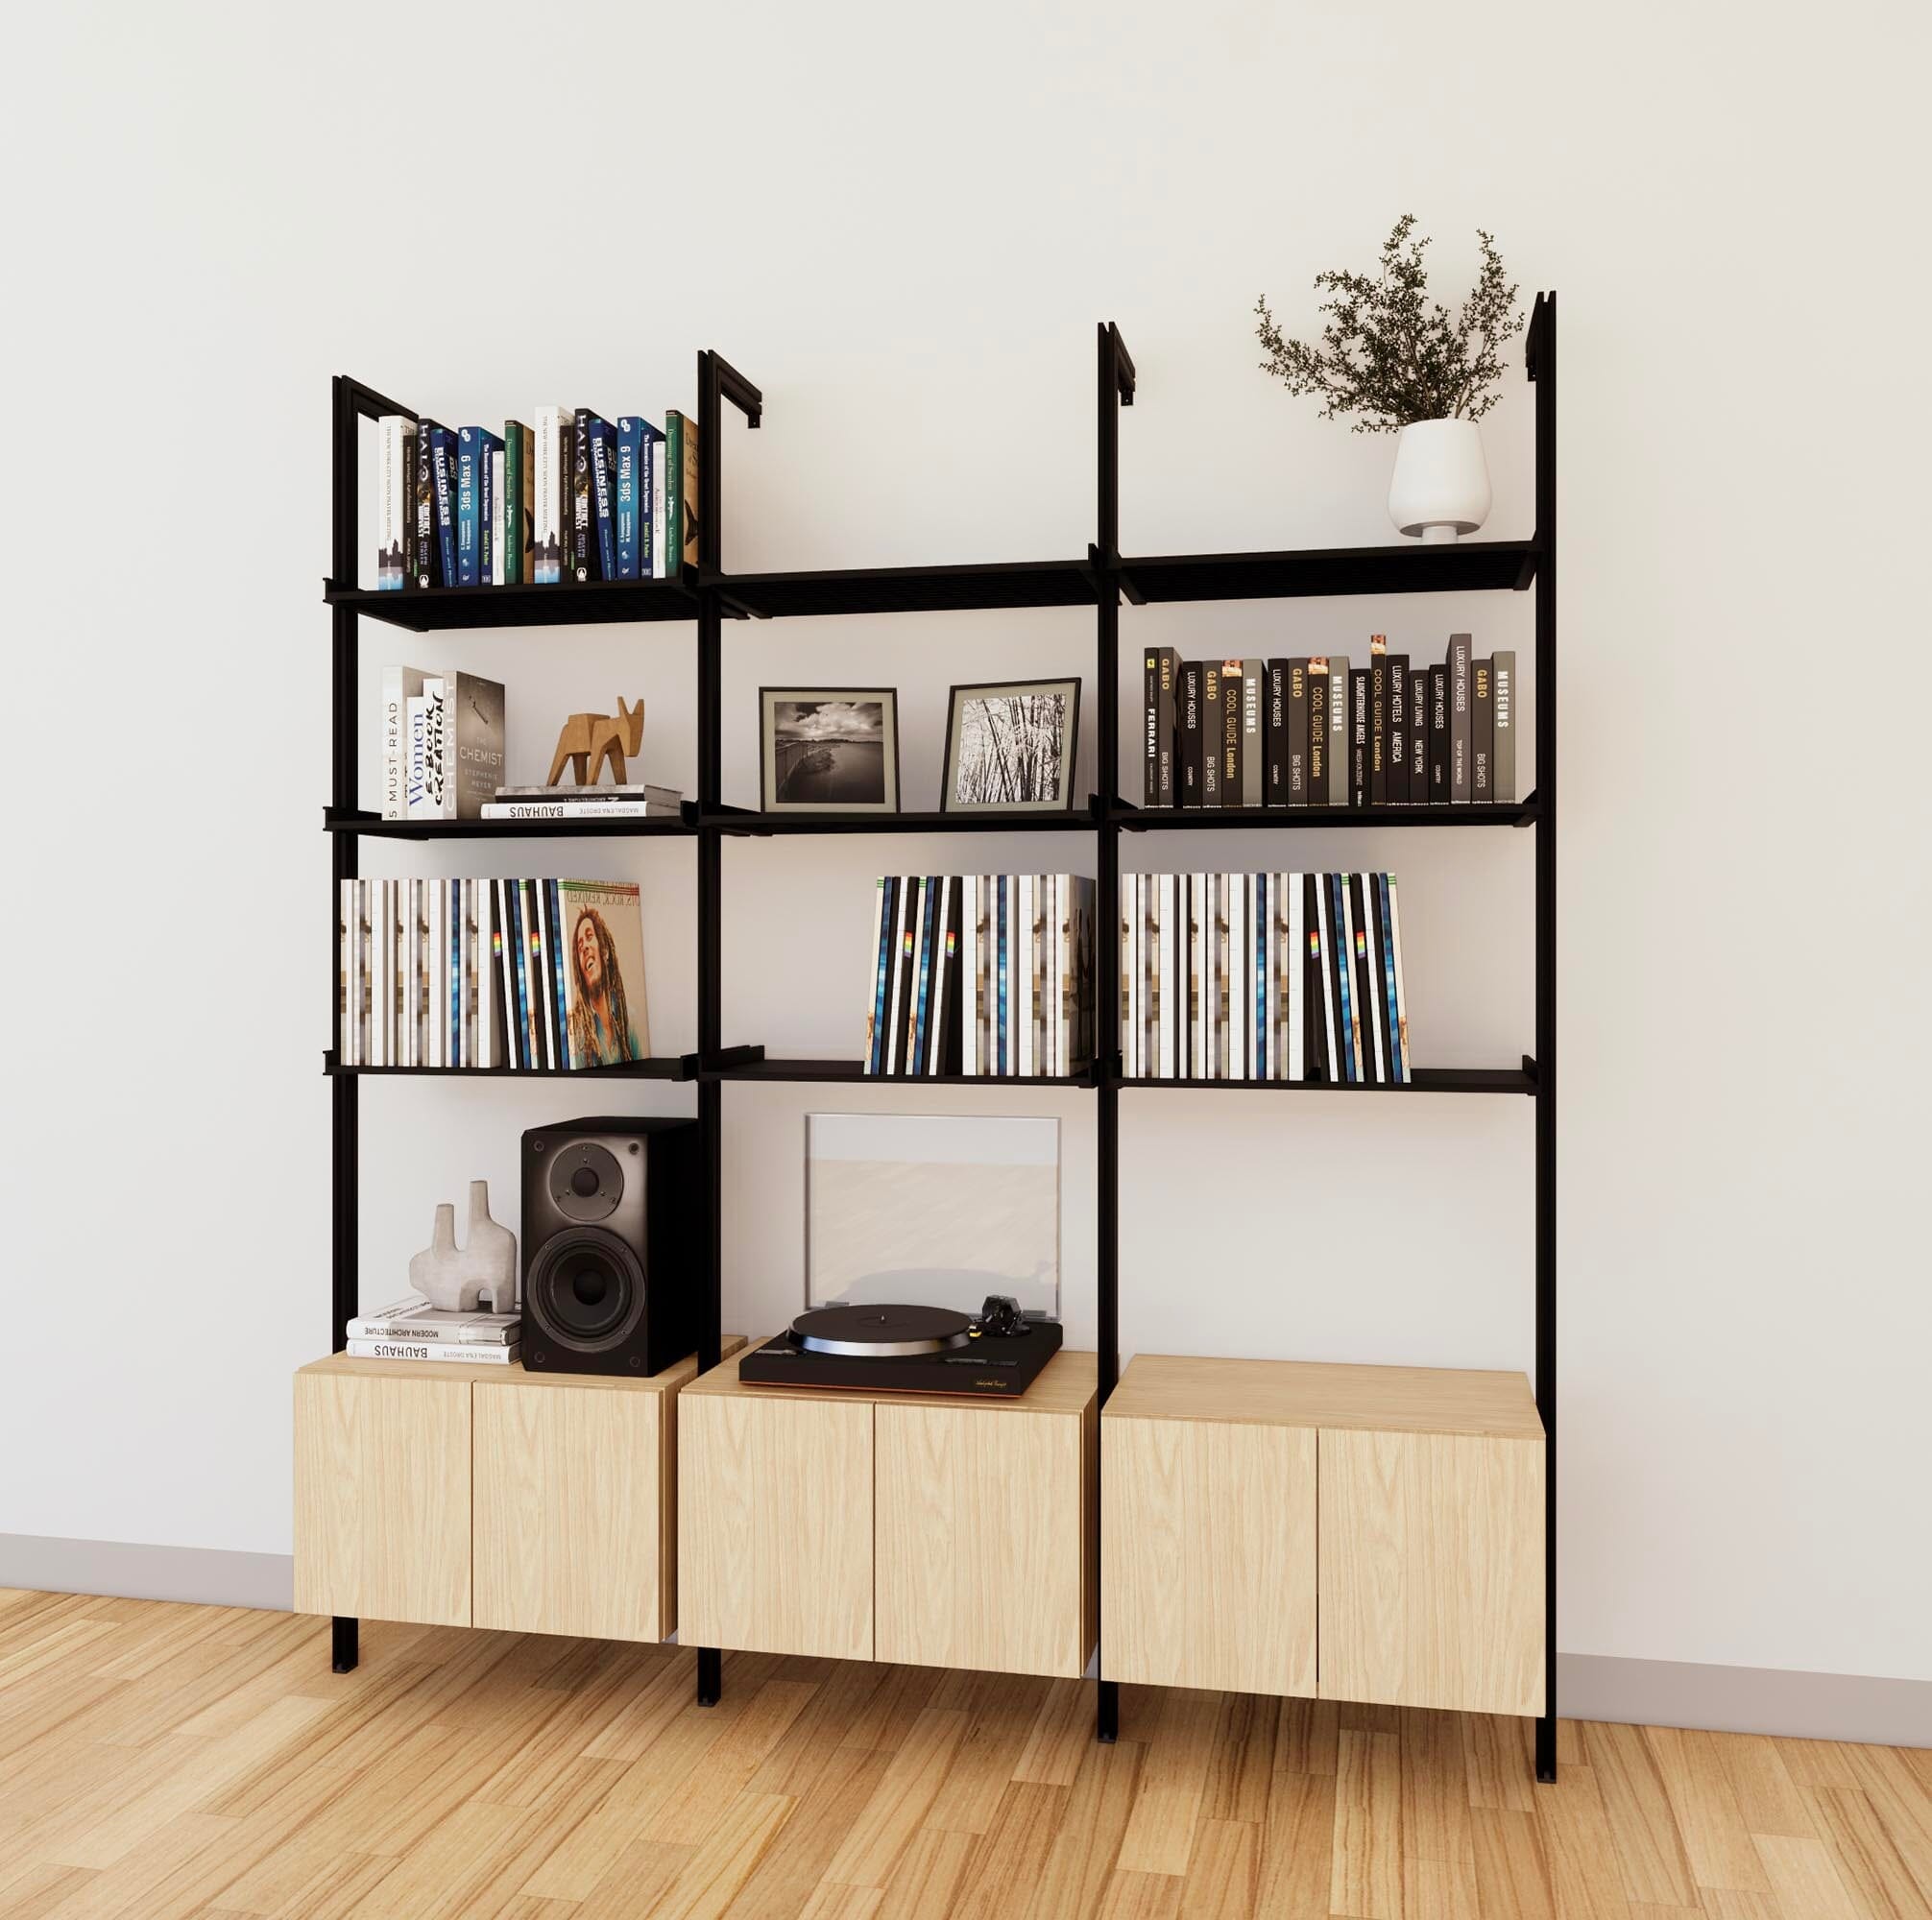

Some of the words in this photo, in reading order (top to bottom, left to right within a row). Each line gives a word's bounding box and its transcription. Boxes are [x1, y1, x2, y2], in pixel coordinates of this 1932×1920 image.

[418, 424, 429, 482] HALO
[576, 414, 586, 472] HALO
[461, 465, 471, 488] Max
[595, 437, 609, 518] BUSINESS
[620, 456, 630, 478] Max
[437, 446, 450, 526] BUSINESS
[620, 482, 631, 501] 3ds
[461, 492, 471, 511] 3ds
[1456, 646, 1464, 677] LUXURY
[1187, 672, 1195, 699] LUXURY
[1207, 671, 1217, 700] GABO
[1272, 669, 1281, 697] LUXURY
[1292, 668, 1302, 698] GABO
[1392, 665, 1402, 693] LUXURY
[1414, 680, 1423, 705] LUXURY
[1435, 674, 1444, 700] LUXURY
[1477, 669, 1487, 698] GABO
[1226, 689, 1236, 714] COOL
[1246, 678, 1256, 733] MUSEUMS
[1313, 686, 1322, 712] COOL
[1333, 676, 1342, 732] MUSEUMS
[1356, 676, 1365, 723] SLAUGHTERHOUSE
[1456, 679, 1464, 711] HOUSES
[1498, 671, 1509, 728] MUSEUMS
[1187, 700, 1195, 729] HOUSES
[1392, 695, 1402, 723] HOTELS
[1436, 702, 1444, 729] HOUSES
[1226, 717, 1236, 744] GUIDE
[1313, 715, 1322, 742] GUIDE
[1356, 724, 1364, 744] ANGELS
[409, 713, 423, 806] Women
[425, 704, 434, 795] E-BOOK
[432, 691, 444, 805] CREATION
[447, 681, 455, 811] CHEMIST
[459, 747, 503, 766] CHEMIST
[1392, 732, 1402, 763] AMERICA
[1477, 754, 1485, 764] BIG
[1206, 756, 1215, 768] BIG
[1226, 748, 1236, 779] London
[1292, 755, 1301, 766] BIG
[1313, 746, 1321, 777] London
[1206, 769, 1215, 792] SHOTS
[1292, 768, 1301, 790] SHOTS
[1477, 766, 1485, 787] SHOTS
[509, 805, 564, 817] BAUHAUS
[365, 1327, 411, 1336] ARCHITECTURE
[411, 1330, 439, 1338] MODERN
[374, 1345, 427, 1358] BAUHAUS
